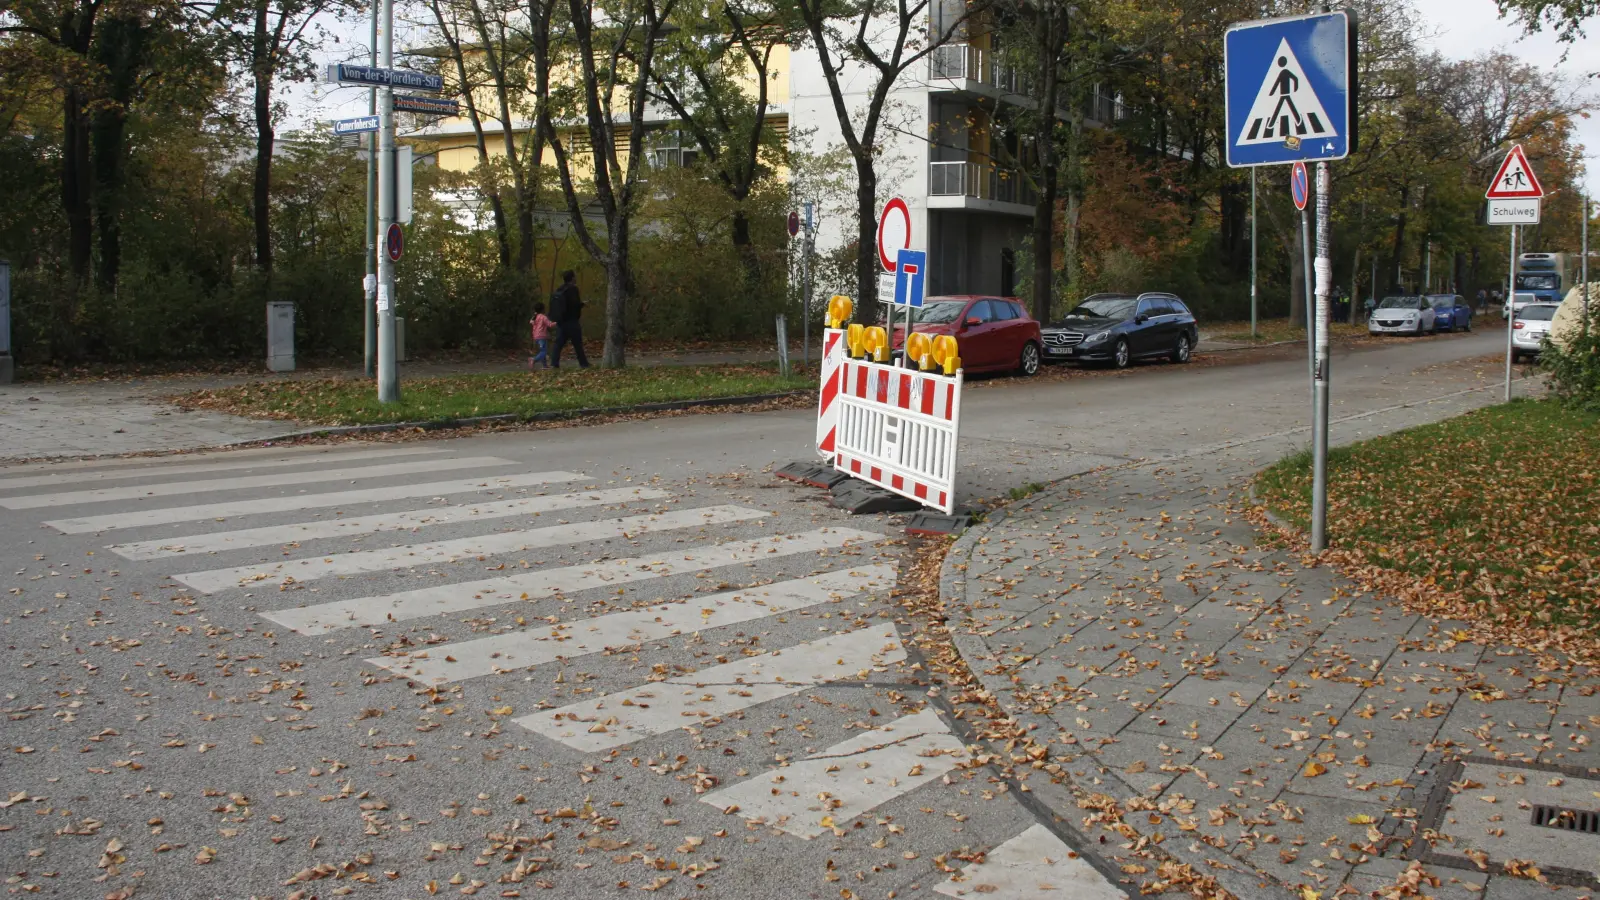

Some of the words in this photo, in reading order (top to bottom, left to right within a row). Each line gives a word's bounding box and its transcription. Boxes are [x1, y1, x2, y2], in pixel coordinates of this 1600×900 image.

[342, 66, 440, 88] Von-der-Pfordten-Str.
[336, 118, 378, 132] Camerloherstr.
[1493, 207, 1535, 217] Schulweg
